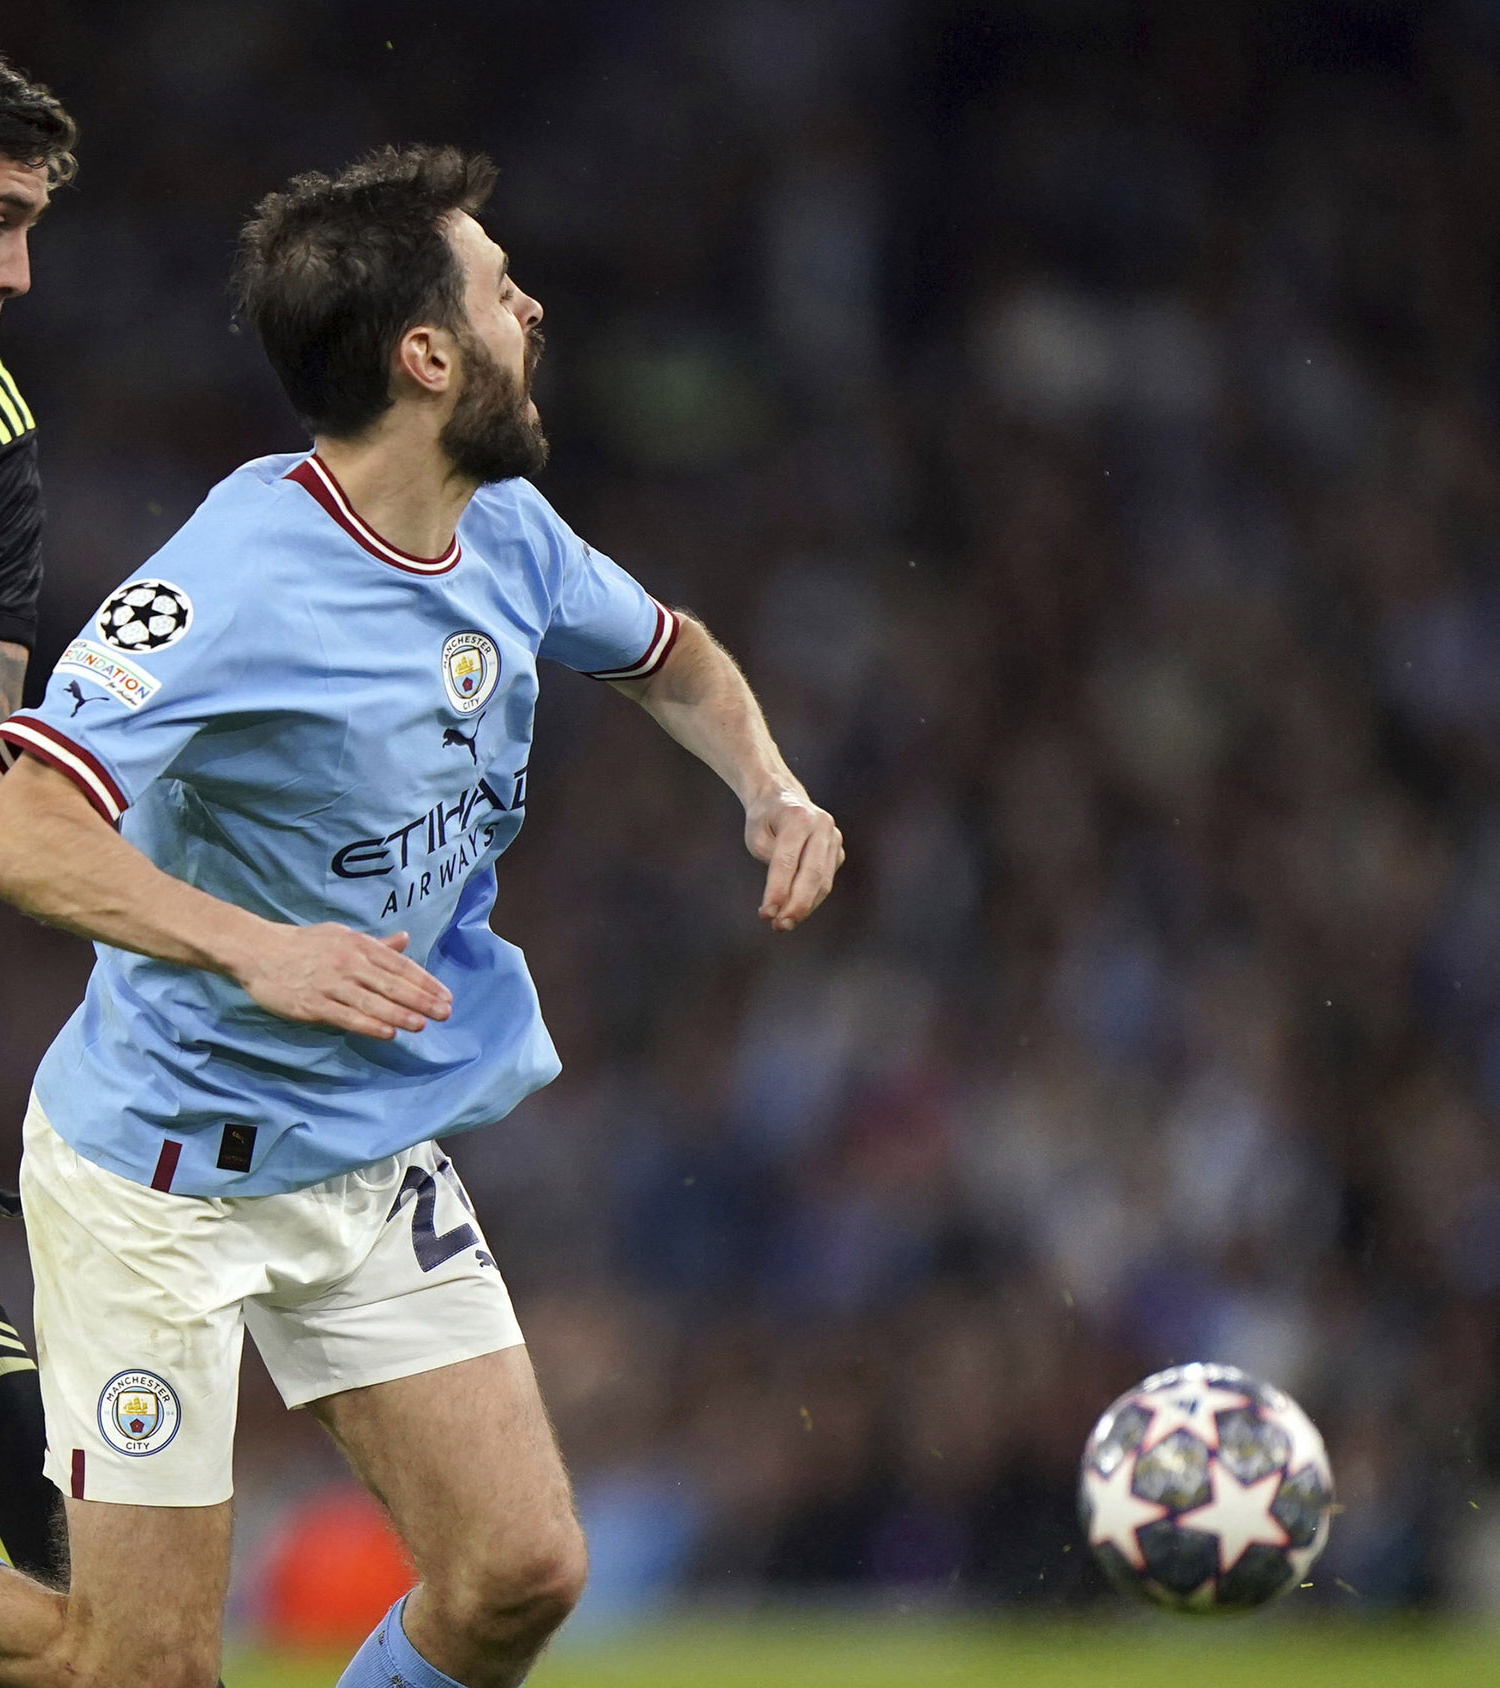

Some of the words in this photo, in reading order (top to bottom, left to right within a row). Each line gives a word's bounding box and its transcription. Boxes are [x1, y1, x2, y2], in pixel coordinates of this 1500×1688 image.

[443, 635, 492, 670] MANCHESTER
[64, 650, 150, 699] FOUNDATION
[462, 697, 481, 710] CITY
[380, 821, 499, 919] AIRWAYS
[106, 1376, 171, 1403] MANCHESTER
[125, 1442, 150, 1450] CITY
